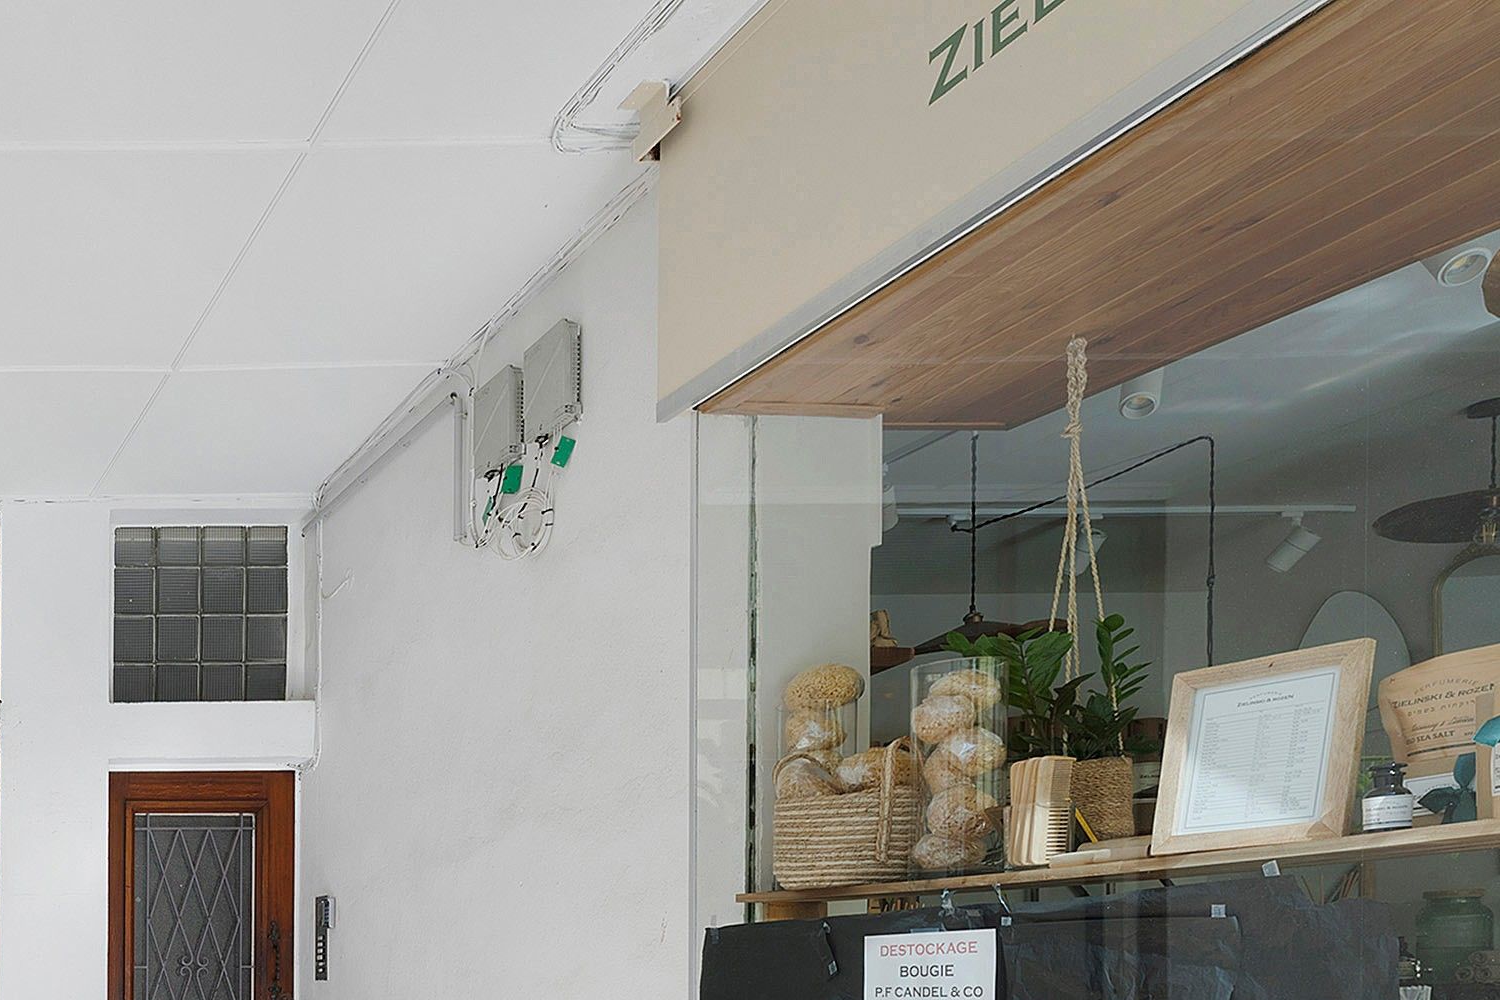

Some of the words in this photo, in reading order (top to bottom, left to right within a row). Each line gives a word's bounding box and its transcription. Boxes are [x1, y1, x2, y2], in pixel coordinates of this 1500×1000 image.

[1445, 690, 1457, 699] &
[880, 941, 978, 957] DESTOCKAGE
[900, 964, 954, 978] BOUGIE
[894, 986, 947, 998] CANDEL
[951, 986, 960, 998] &
[963, 986, 983, 998] CO
